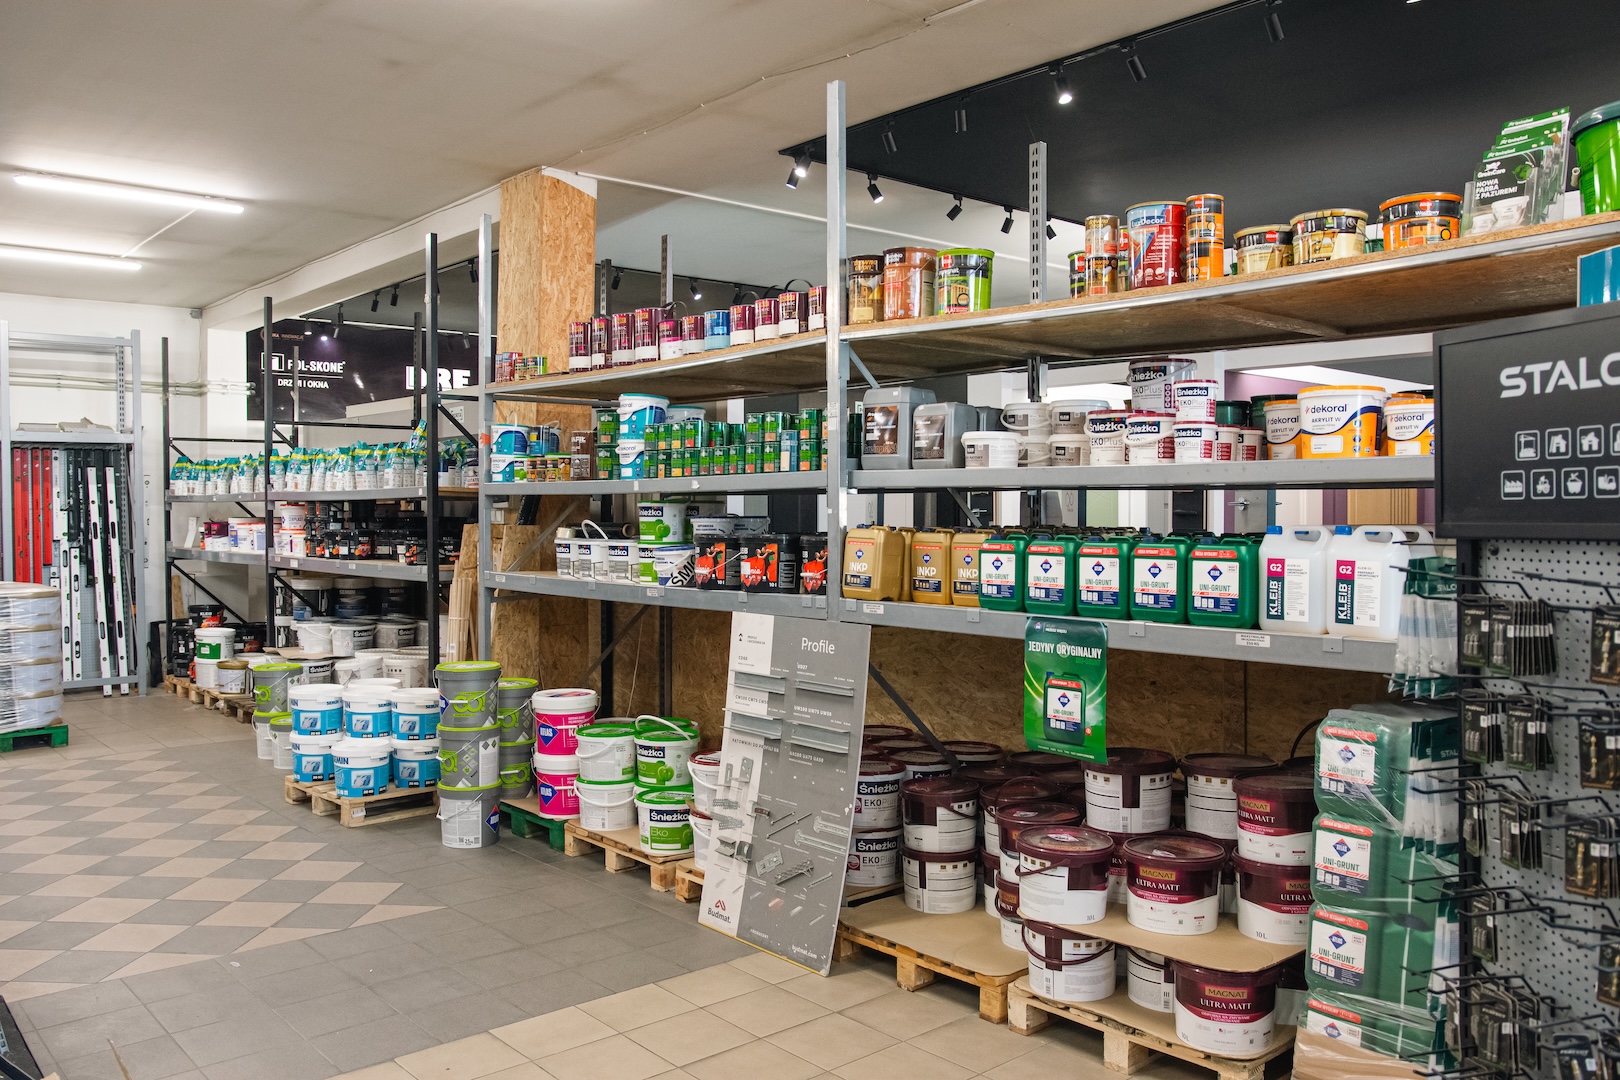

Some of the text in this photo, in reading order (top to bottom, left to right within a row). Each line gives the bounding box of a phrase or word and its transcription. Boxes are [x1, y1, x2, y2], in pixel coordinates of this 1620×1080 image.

[1477, 178, 1498, 187] NOWA
[406, 366, 470, 390] DRE
[307, 380, 329, 388] OKNA
[1176, 388, 1207, 396] Śnieżka
[1311, 404, 1347, 414] dekoral
[1271, 415, 1299, 425] dekoral
[1394, 413, 1424, 423] dekoral
[609, 548, 627, 556] ieżka
[852, 562, 868, 571] NKP
[919, 567, 936, 576] NKP
[1270, 563, 1282, 572] G2
[1339, 566, 1352, 574] G2
[960, 569, 978, 578] NKP
[1140, 581, 1169, 589] UNI-GRUNT
[1199, 584, 1231, 592] UNI-GRUNT
[1269, 580, 1278, 615] KLEIB
[1338, 583, 1347, 619] KLEIB
[801, 637, 835, 654] Profile
[1028, 641, 1102, 659] JEDYNY ORYGINALNY
[453, 694, 486, 713] GO!
[1053, 708, 1075, 716] UNI-GRUNT
[540, 727, 553, 737] ATLAS
[501, 764, 530, 784] GO!
[1328, 764, 1365, 777] UNI-GRUNT
[860, 782, 898, 794] Śnieżka
[651, 810, 690, 822] Śnieżka
[1255, 814, 1275, 823] MATT
[651, 829, 668, 837] Eko
[858, 839, 897, 850] Śnieżka
[1323, 857, 1360, 871] UNI-GRUNT
[1141, 868, 1174, 879] MAGNAT
[1136, 878, 1180, 891] ULTRA MATT
[792, 944, 817, 959] budmat.com
[1318, 947, 1355, 964] UNI-GRUNT
[1208, 988, 1246, 998] MAGNAT
[1200, 998, 1226, 1009] ULTRA
